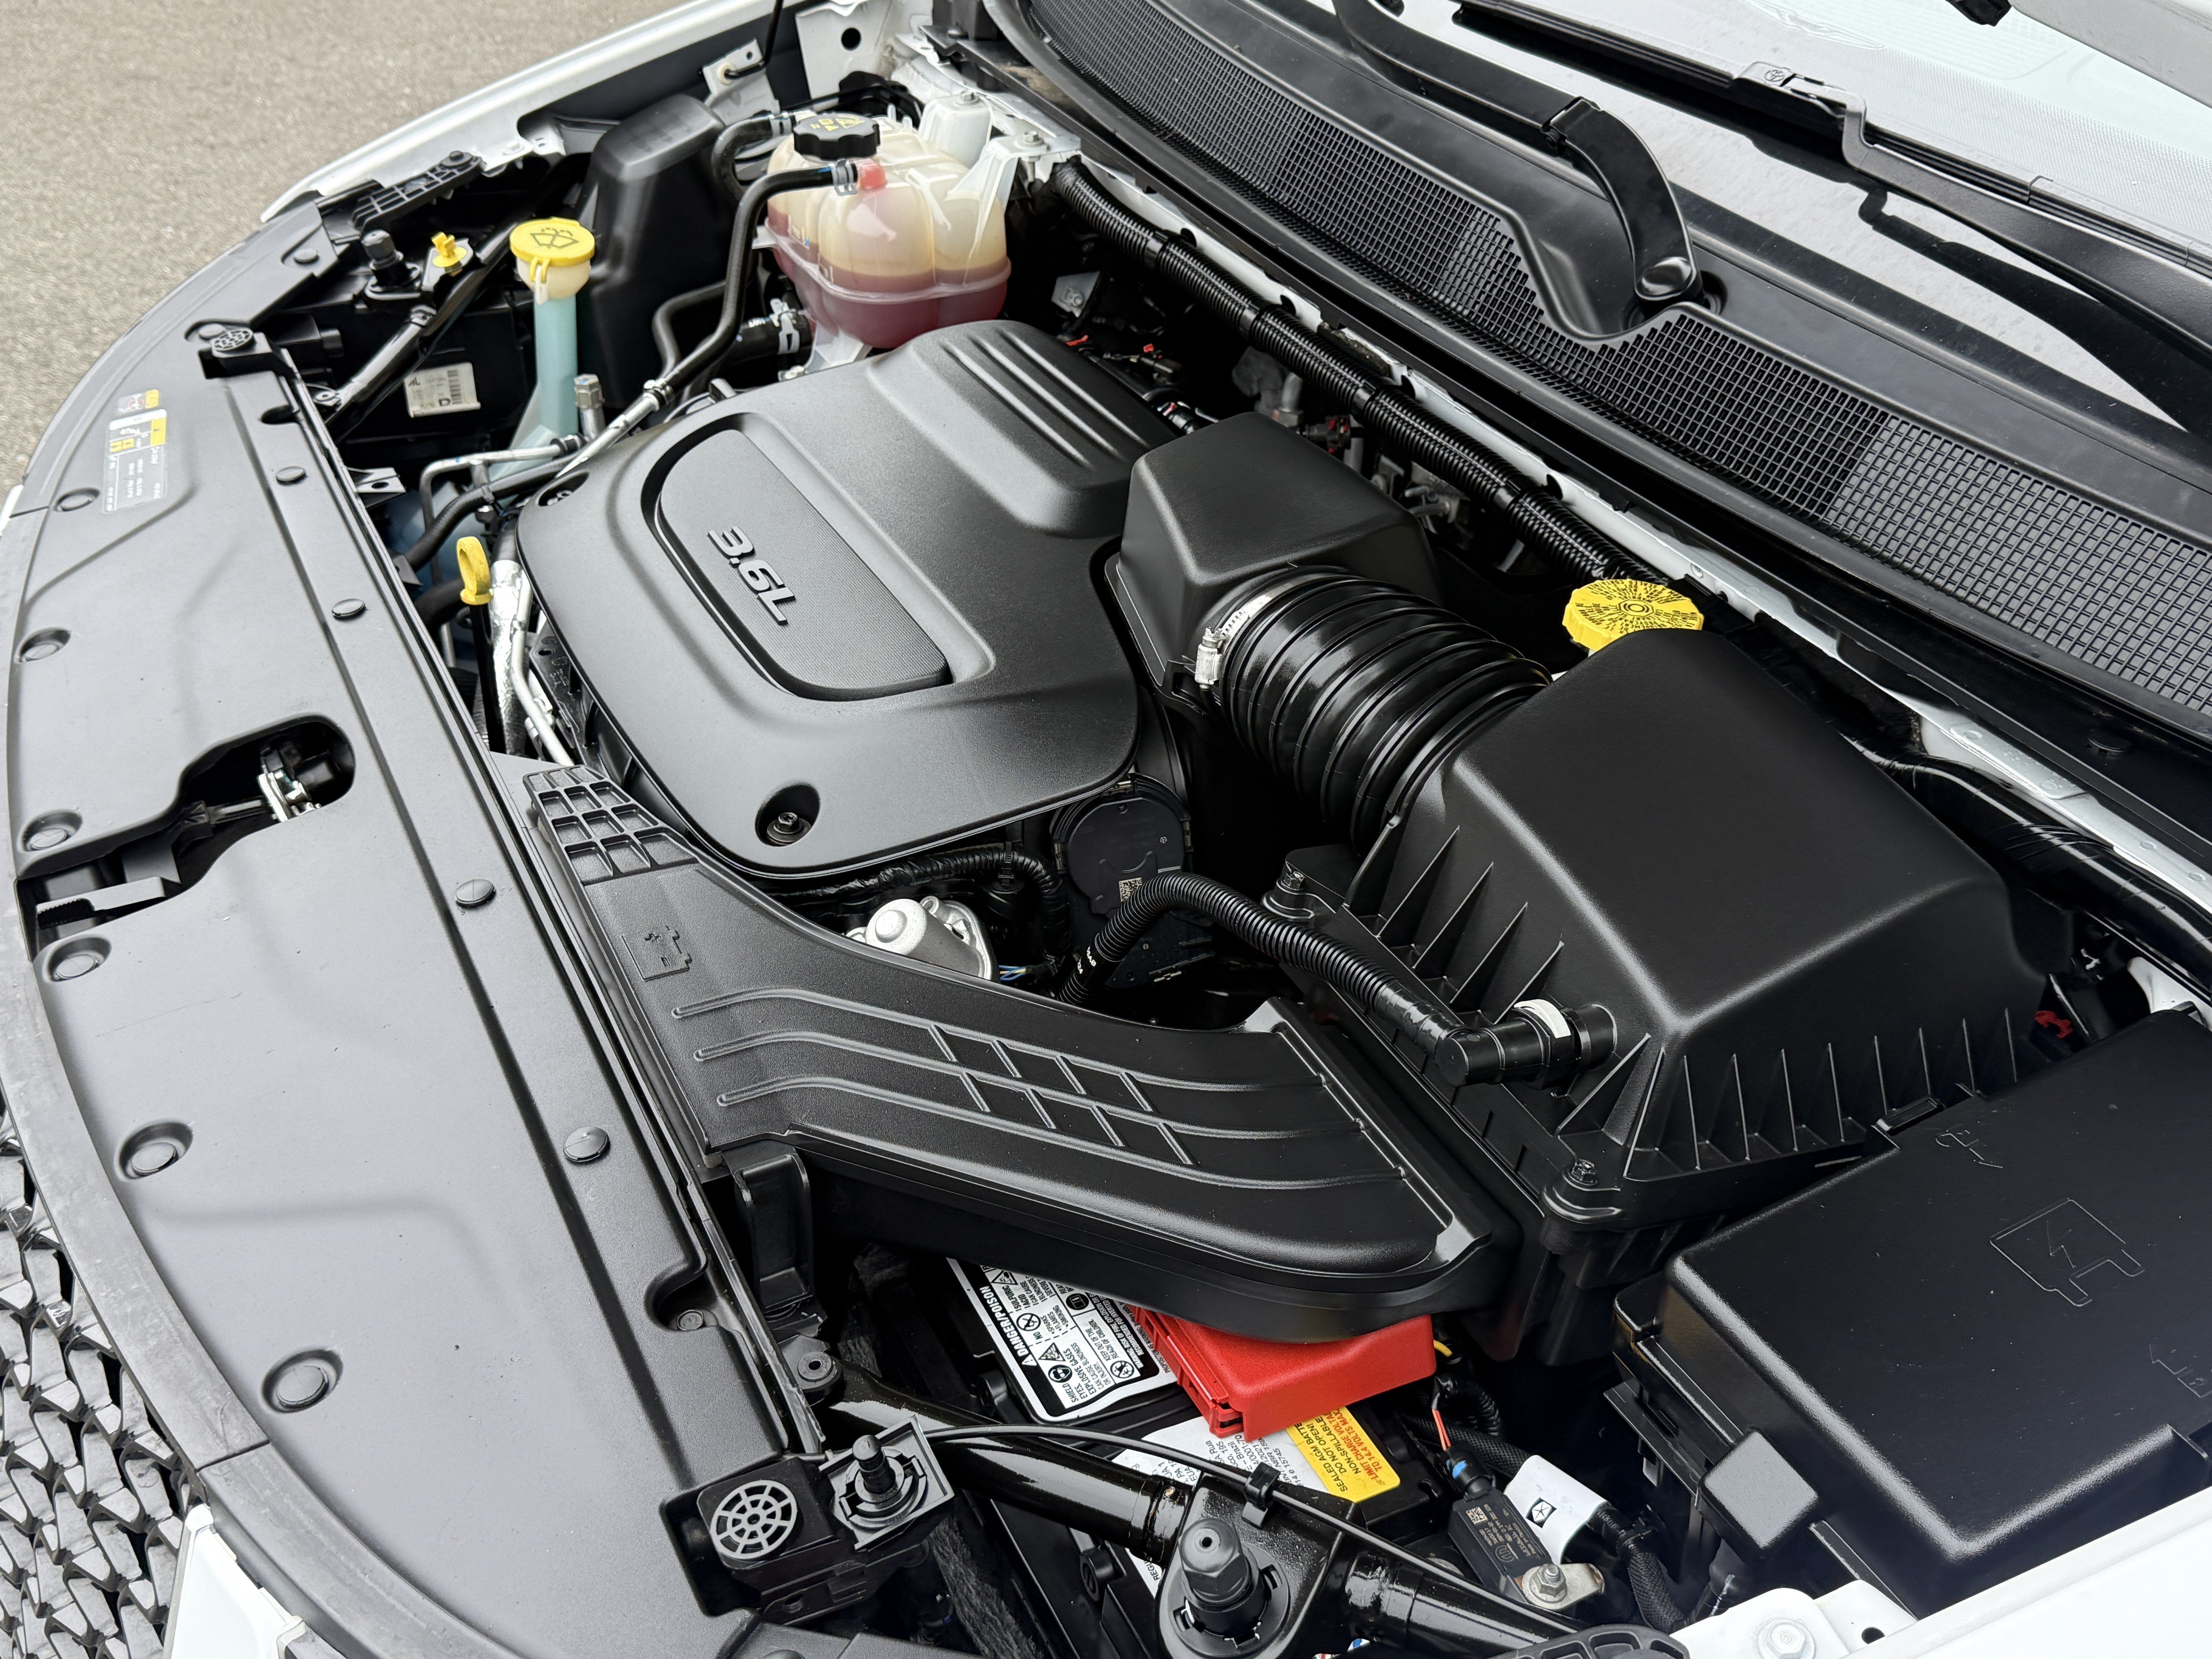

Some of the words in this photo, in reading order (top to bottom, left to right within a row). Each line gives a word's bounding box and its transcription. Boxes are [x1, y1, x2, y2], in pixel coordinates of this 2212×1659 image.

[708, 526, 795, 625] 3.6L
[1019, 1280, 1033, 1294] CAUSE
[1026, 1277, 1047, 1300] BLINDNESS
[1038, 1280, 1054, 1296] SEVERE
[1001, 1285, 1022, 1309] SULFURIC
[1017, 1293, 1031, 1306] ACID
[1027, 1293, 1039, 1303] CAN
[1094, 1302, 1114, 1323] EXPLOSION
[1101, 1299, 1119, 1318] INVERTED
[978, 1285, 1030, 1357] DANGER/POISON
[1113, 1316, 1124, 1325] FOR
[1032, 1331, 1043, 1340] NO
[1084, 1327, 1096, 1337] THE
[1118, 1324, 1145, 1356] RECOMMENDED
[1094, 1341, 1104, 1350] OUT
[1104, 1343, 1119, 1359] REACH
[1119, 1337, 1131, 1348] RISK
[1061, 1348, 1080, 1366] GASES
[1069, 1342, 1090, 1366] BLINDNESS
[1099, 1350, 1112, 1361] KEEP
[1073, 1365, 1098, 1395] EXPLOSIVE
[1084, 1364, 1099, 1380] CAUSE
[1060, 1382, 1080, 1402] SHIELD
[1072, 1382, 1089, 1399] EYES.
[1093, 1379, 1105, 1389] CAN
[1344, 1425, 1365, 1446] VOLTS
[1204, 1440, 1218, 1455] Rua
[1215, 1440, 1228, 1454] 195
[1227, 1441, 1245, 1460] Brazil
[1234, 1434, 1260, 1466] 4/0001-70
[1310, 1444, 1327, 1462] AGM
[1314, 1416, 1362, 1474] NON-SPILLABLE
[1340, 1434, 1365, 1461] CHARGE
[1359, 1446, 1376, 1461] 14.4
[1266, 1451, 1281, 1468] NBR
[1272, 1447, 1291, 1468] 15745
[1322, 1446, 1338, 1462] NOT
[1173, 1468, 1185, 1478] PA
[1333, 1462, 1347, 1474] DO
[1359, 1460, 1379, 1480] LIMIT
[1370, 1460, 1383, 1471] TO
[1322, 1462, 1348, 1492] SEALED
[1143, 1561, 1160, 1581] REGU
